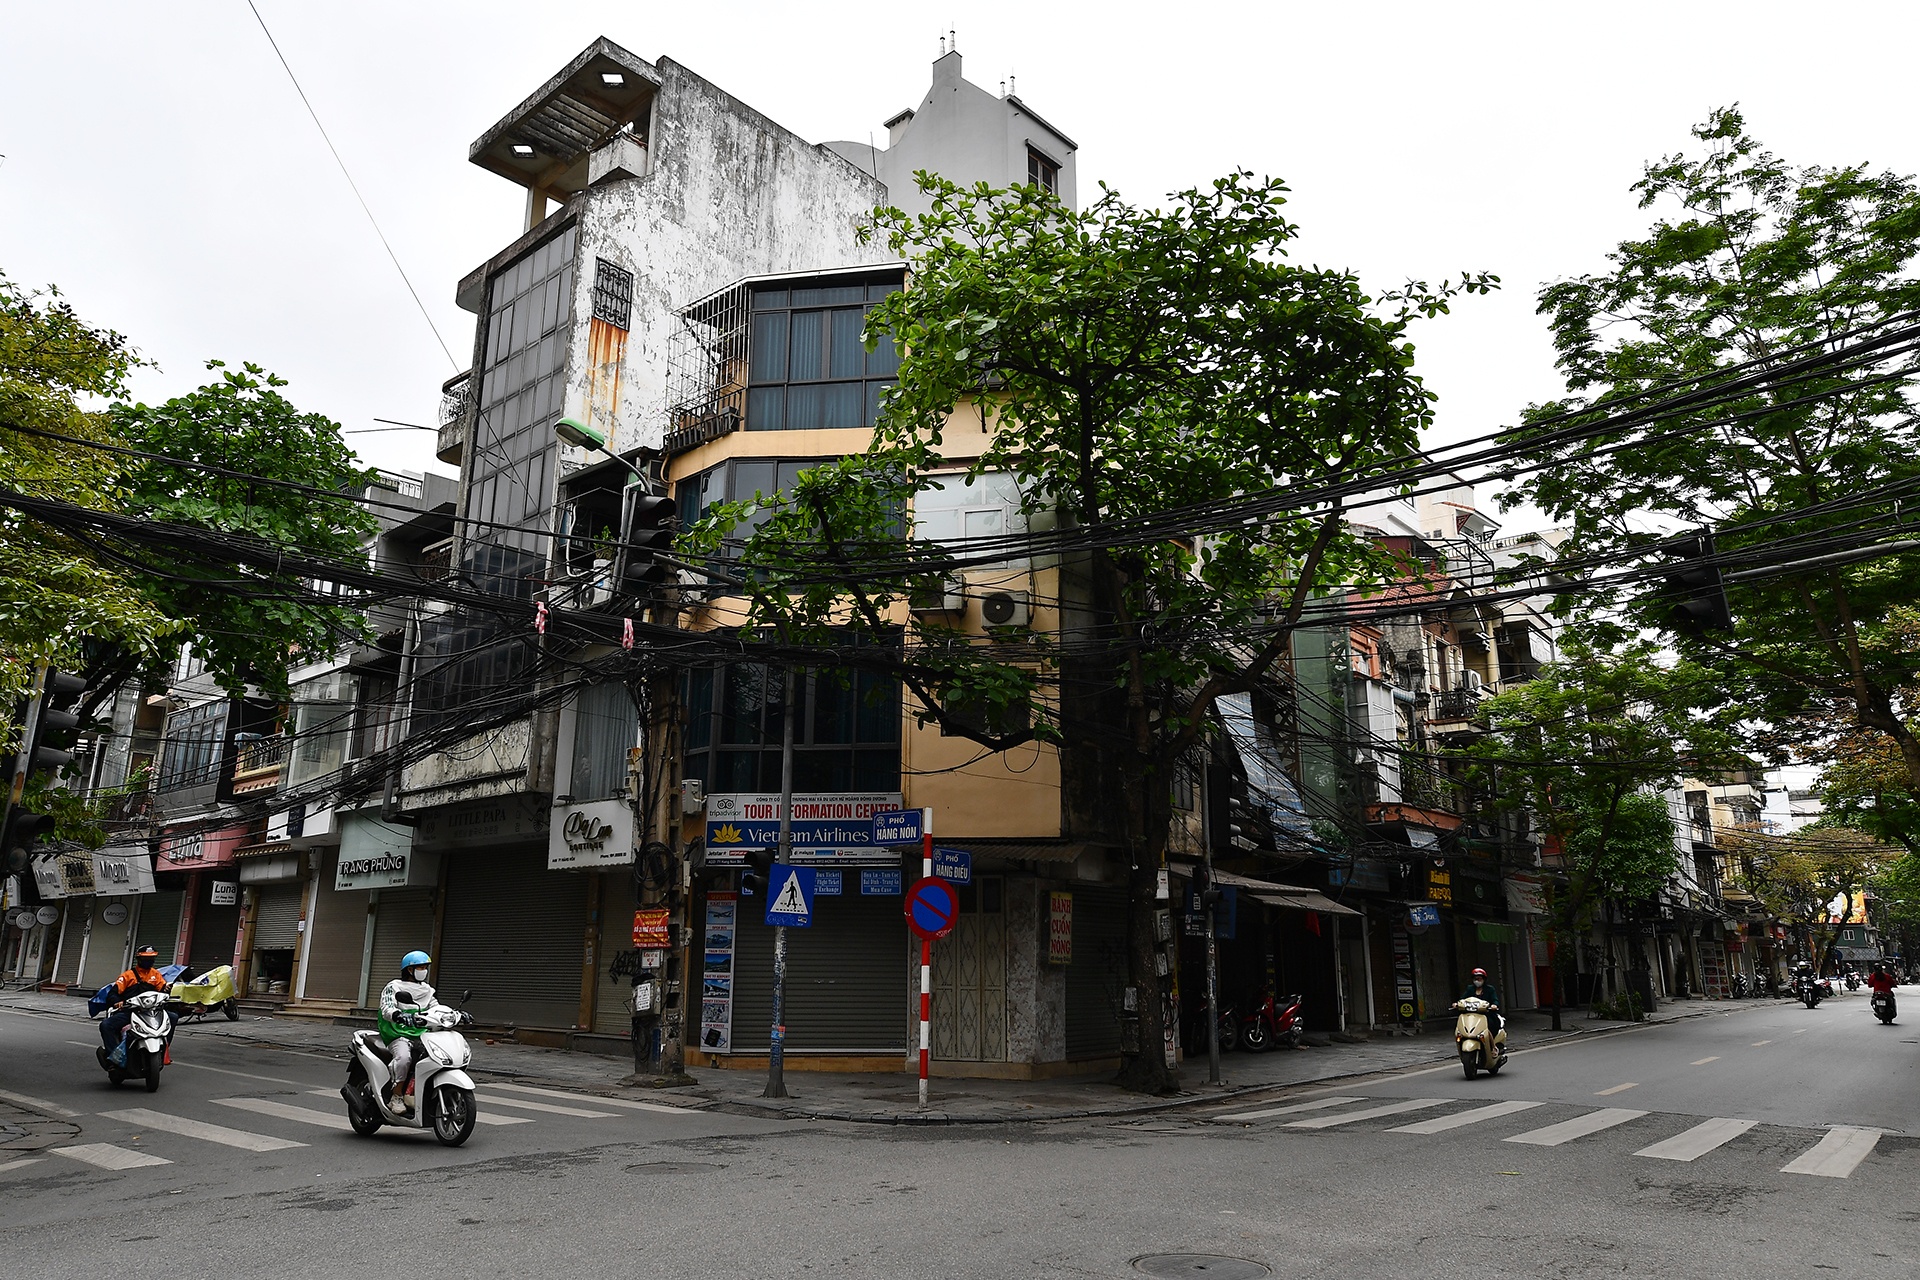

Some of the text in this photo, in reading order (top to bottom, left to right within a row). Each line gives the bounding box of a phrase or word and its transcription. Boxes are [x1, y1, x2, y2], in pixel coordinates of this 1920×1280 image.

[448, 812, 480, 827] LITTLE
[484, 808, 506, 822] PAPA
[710, 808, 742, 817] tripadvisor
[744, 804, 772, 818] TOUR
[776, 804, 852, 818] IFORMATION
[889, 814, 905, 824] PHỐ
[812, 827, 870, 842] Airlines
[876, 824, 916, 840] HÀNG NÓN
[169, 834, 203, 860] Luna
[570, 842, 604, 852] BOUTIQUE
[946, 854, 958, 862] PHỐ
[339, 859, 369, 874] TRANG
[936, 862, 953, 877] HÀNG
[215, 884, 236, 893] Luna
[1052, 894, 1071, 913] BÁNH
[1051, 914, 1070, 935] CUỐN
[1051, 936, 1070, 954] NÓNG
